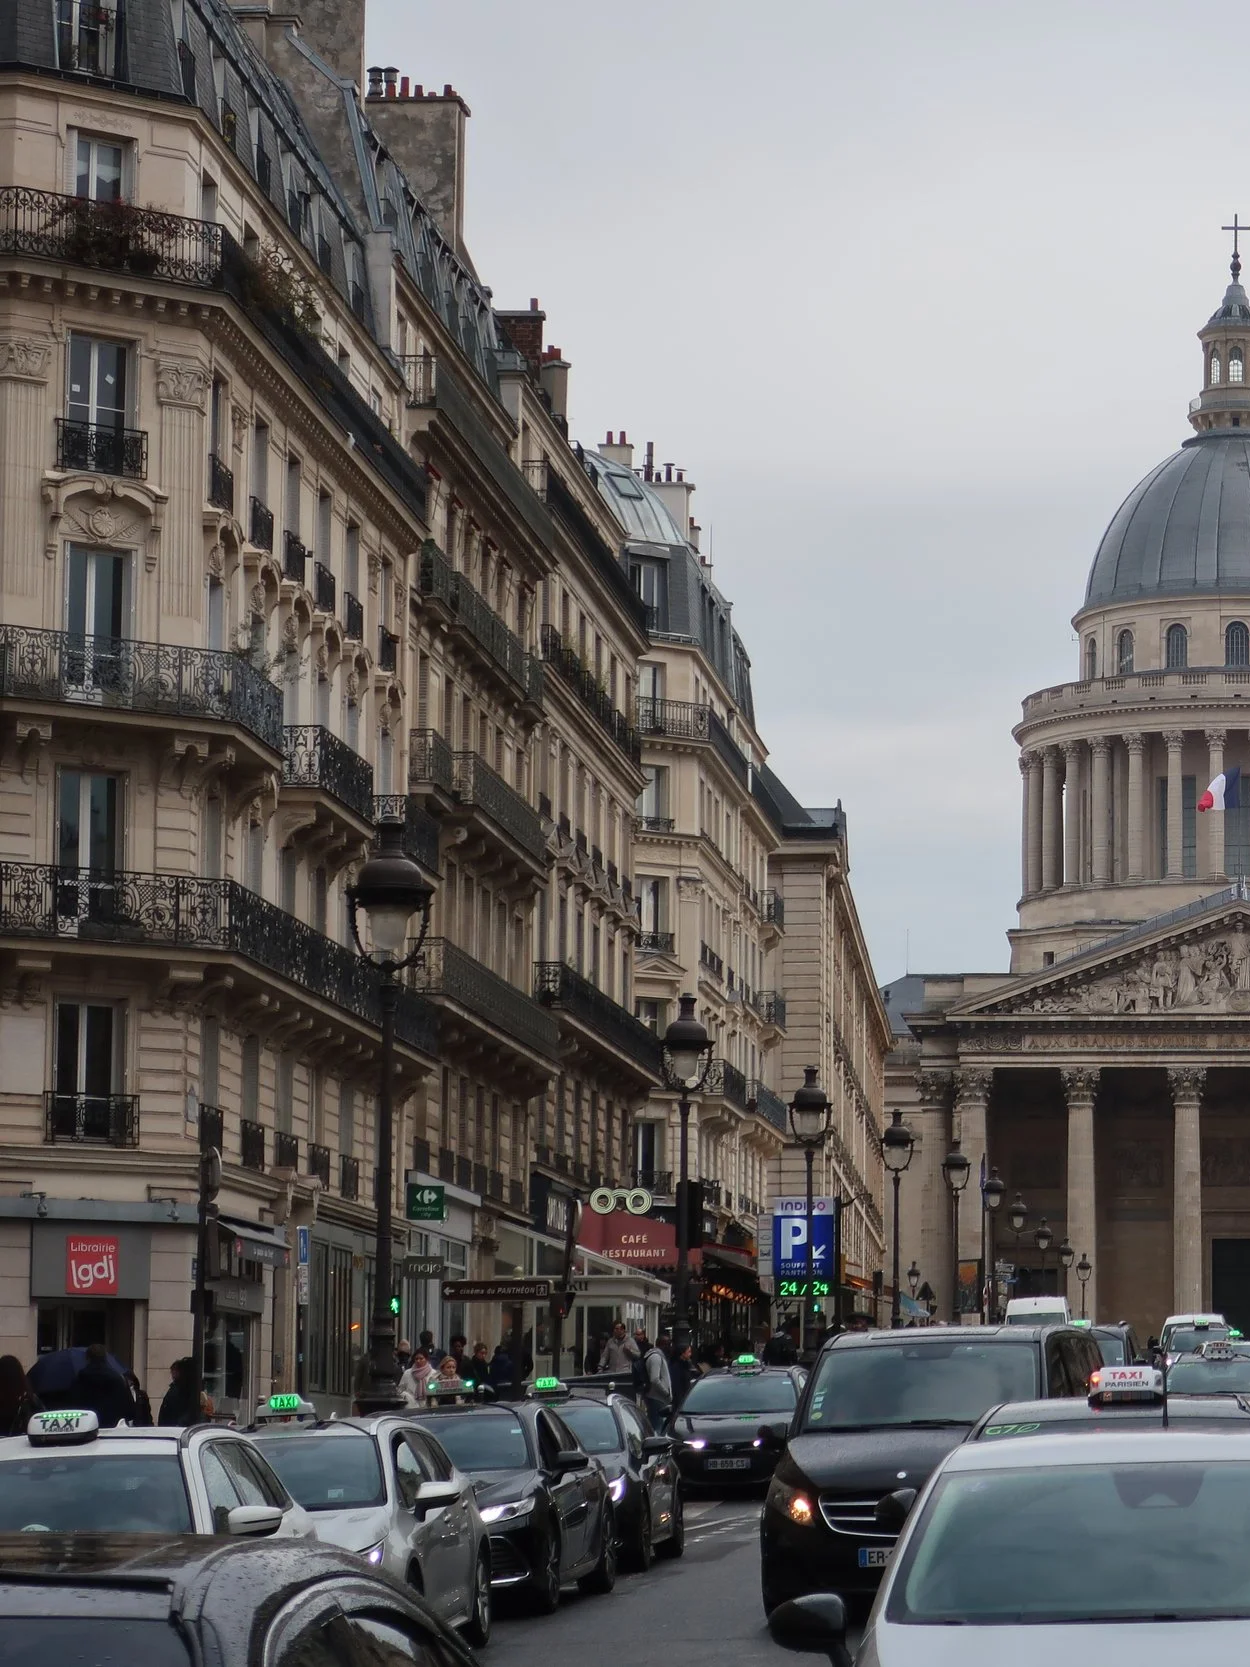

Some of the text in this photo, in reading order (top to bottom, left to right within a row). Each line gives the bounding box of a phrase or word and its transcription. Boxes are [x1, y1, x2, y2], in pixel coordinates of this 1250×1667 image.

[1028, 1035, 1064, 1048] AUX
[1068, 1035, 1136, 1048] GRANDS
[1138, 1035, 1207, 1048] HOMMES
[780, 1218, 808, 1260] P
[70, 1242, 116, 1252] Librairie
[602, 1248, 666, 1258] RESTAURANT
[71, 1254, 115, 1288] lgdj
[487, 1287, 496, 1295] du
[497, 1285, 536, 1295] PANTHÉON
[272, 1397, 296, 1408] TAXI
[40, 1418, 80, 1430] TAXI
